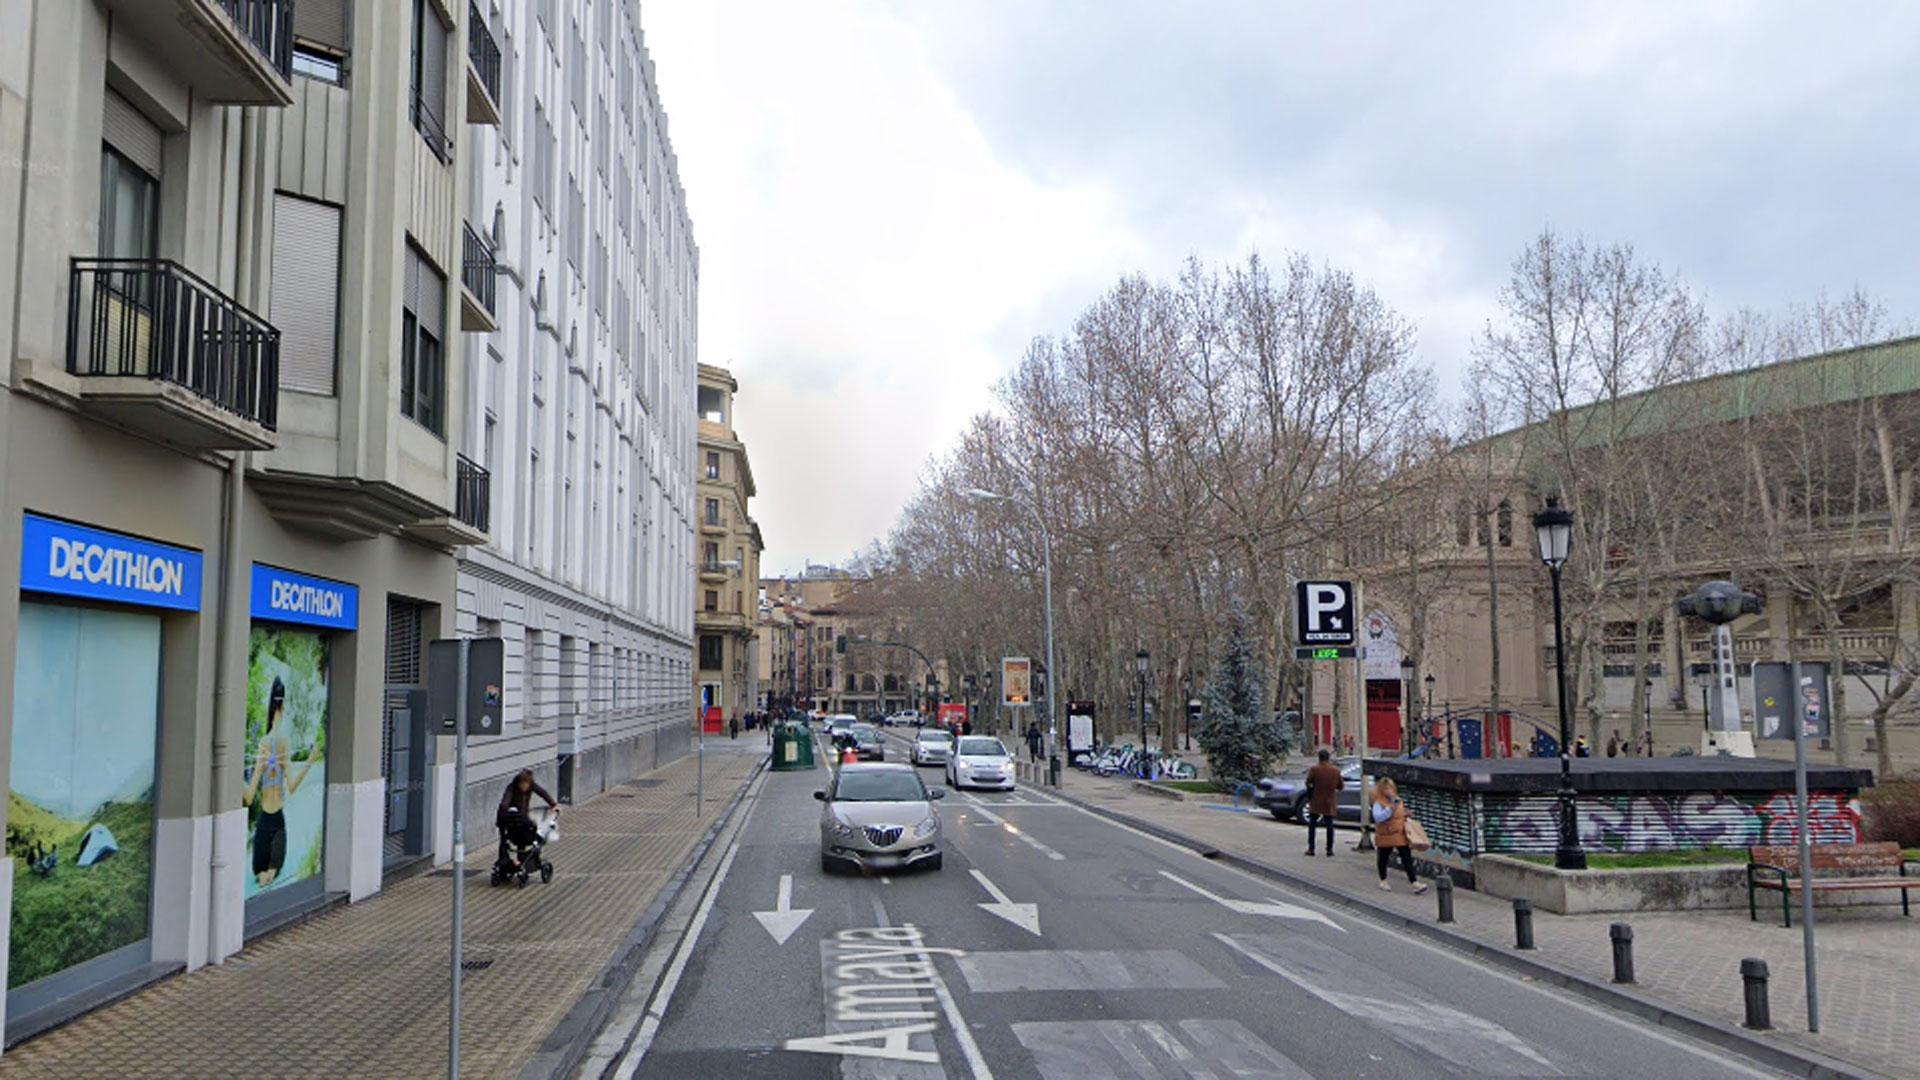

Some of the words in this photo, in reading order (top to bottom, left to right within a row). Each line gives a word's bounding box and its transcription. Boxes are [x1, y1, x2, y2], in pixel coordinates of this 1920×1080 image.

[49, 536, 183, 595] DECATHLON
[270, 580, 344, 618] DECATHLON
[1306, 584, 1346, 631] P
[785, 923, 967, 1062] Amaya
